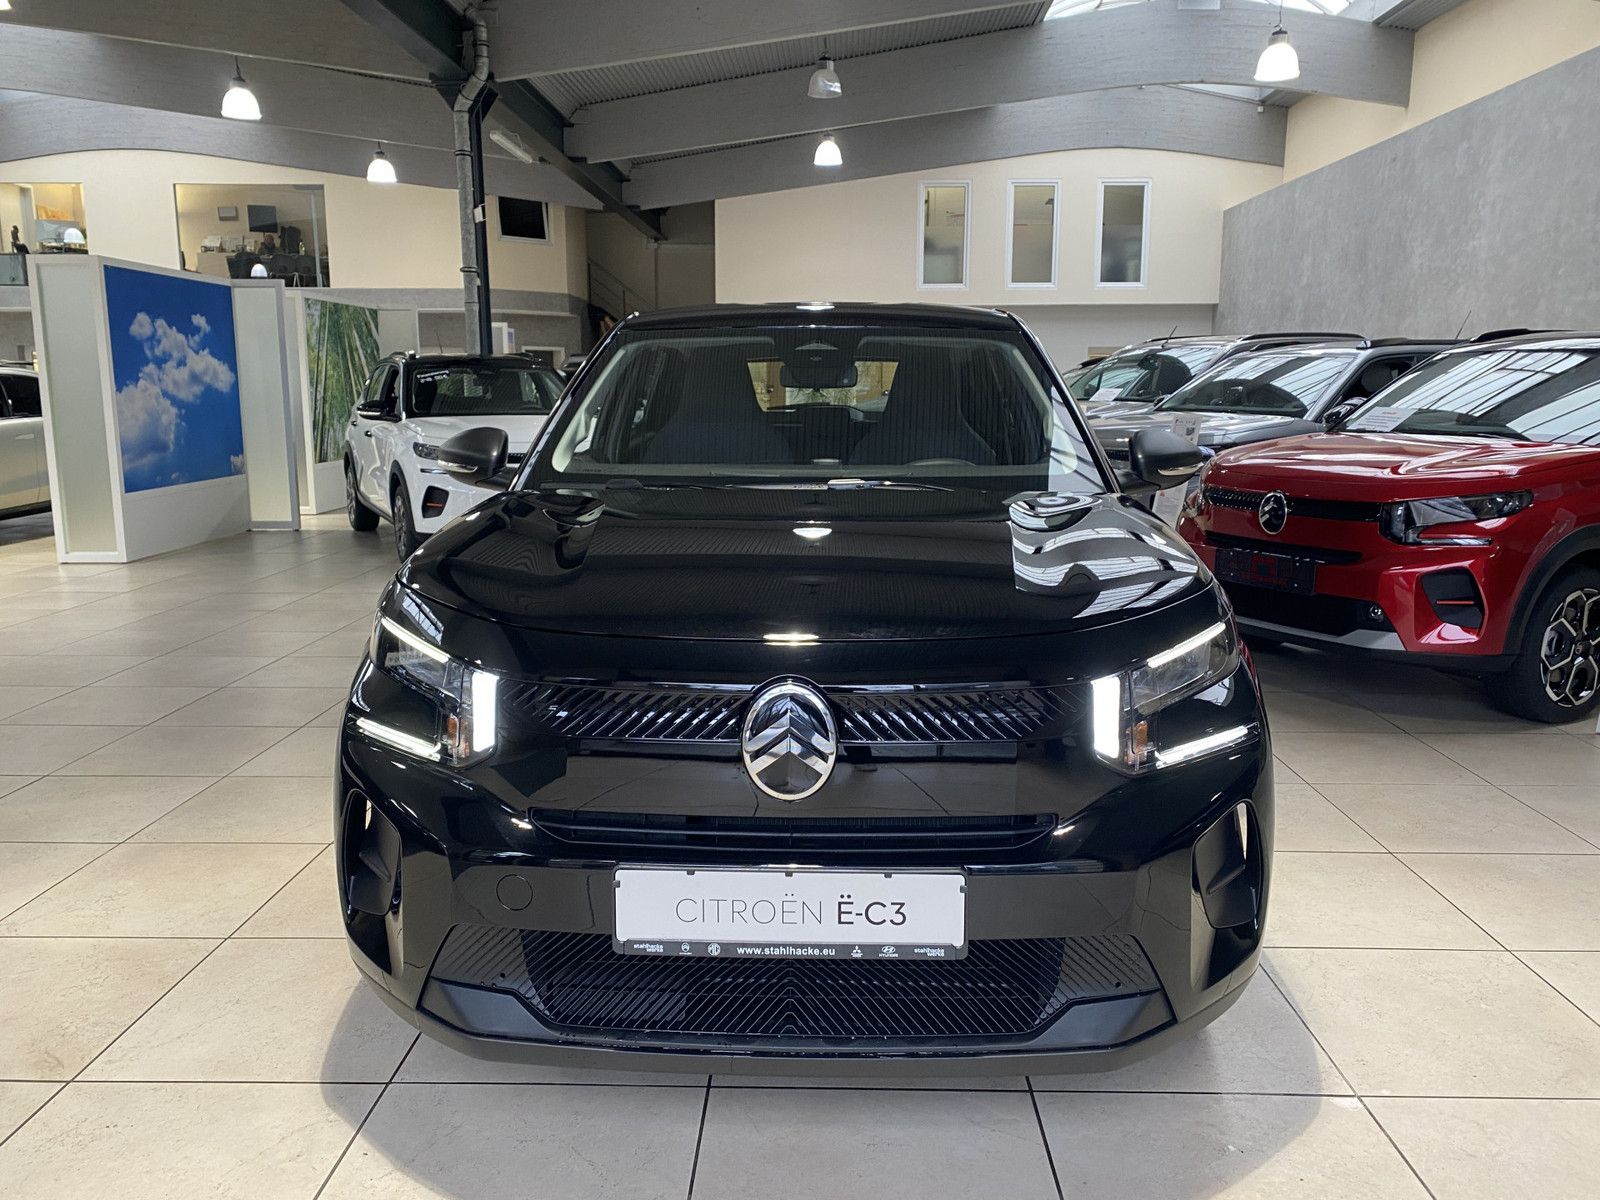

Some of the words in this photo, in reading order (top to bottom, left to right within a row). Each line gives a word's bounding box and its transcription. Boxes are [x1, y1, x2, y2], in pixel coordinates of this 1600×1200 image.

[675, 893, 823, 925] CITROËN
[837, 894, 907, 925] Ë-C3
[736, 945, 836, 957] www.stahlhacke.eu
